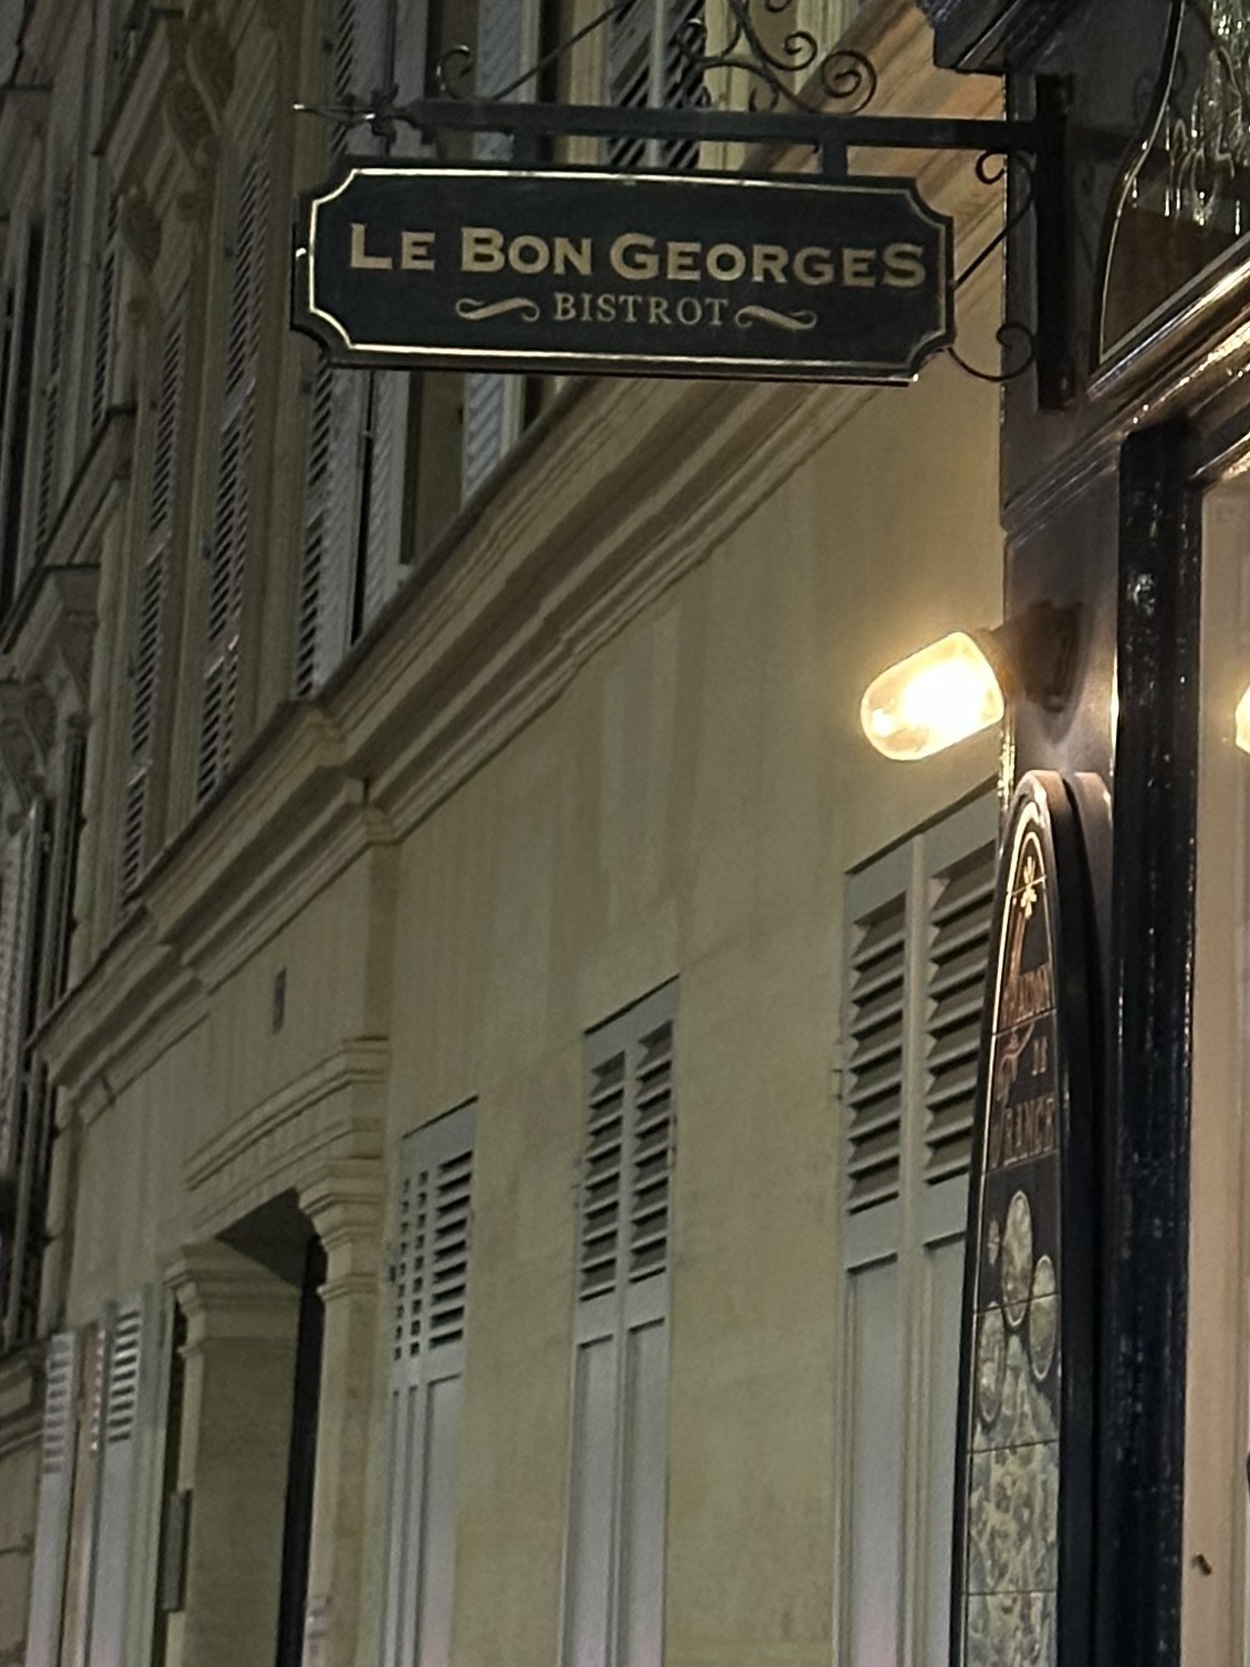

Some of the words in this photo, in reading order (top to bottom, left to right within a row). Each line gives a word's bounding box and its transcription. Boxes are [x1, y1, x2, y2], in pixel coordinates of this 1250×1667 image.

[349, 223, 435, 272] LE
[460, 226, 592, 278] BON
[609, 233, 926, 287] GEORGES
[552, 293, 729, 327] BISTROT
